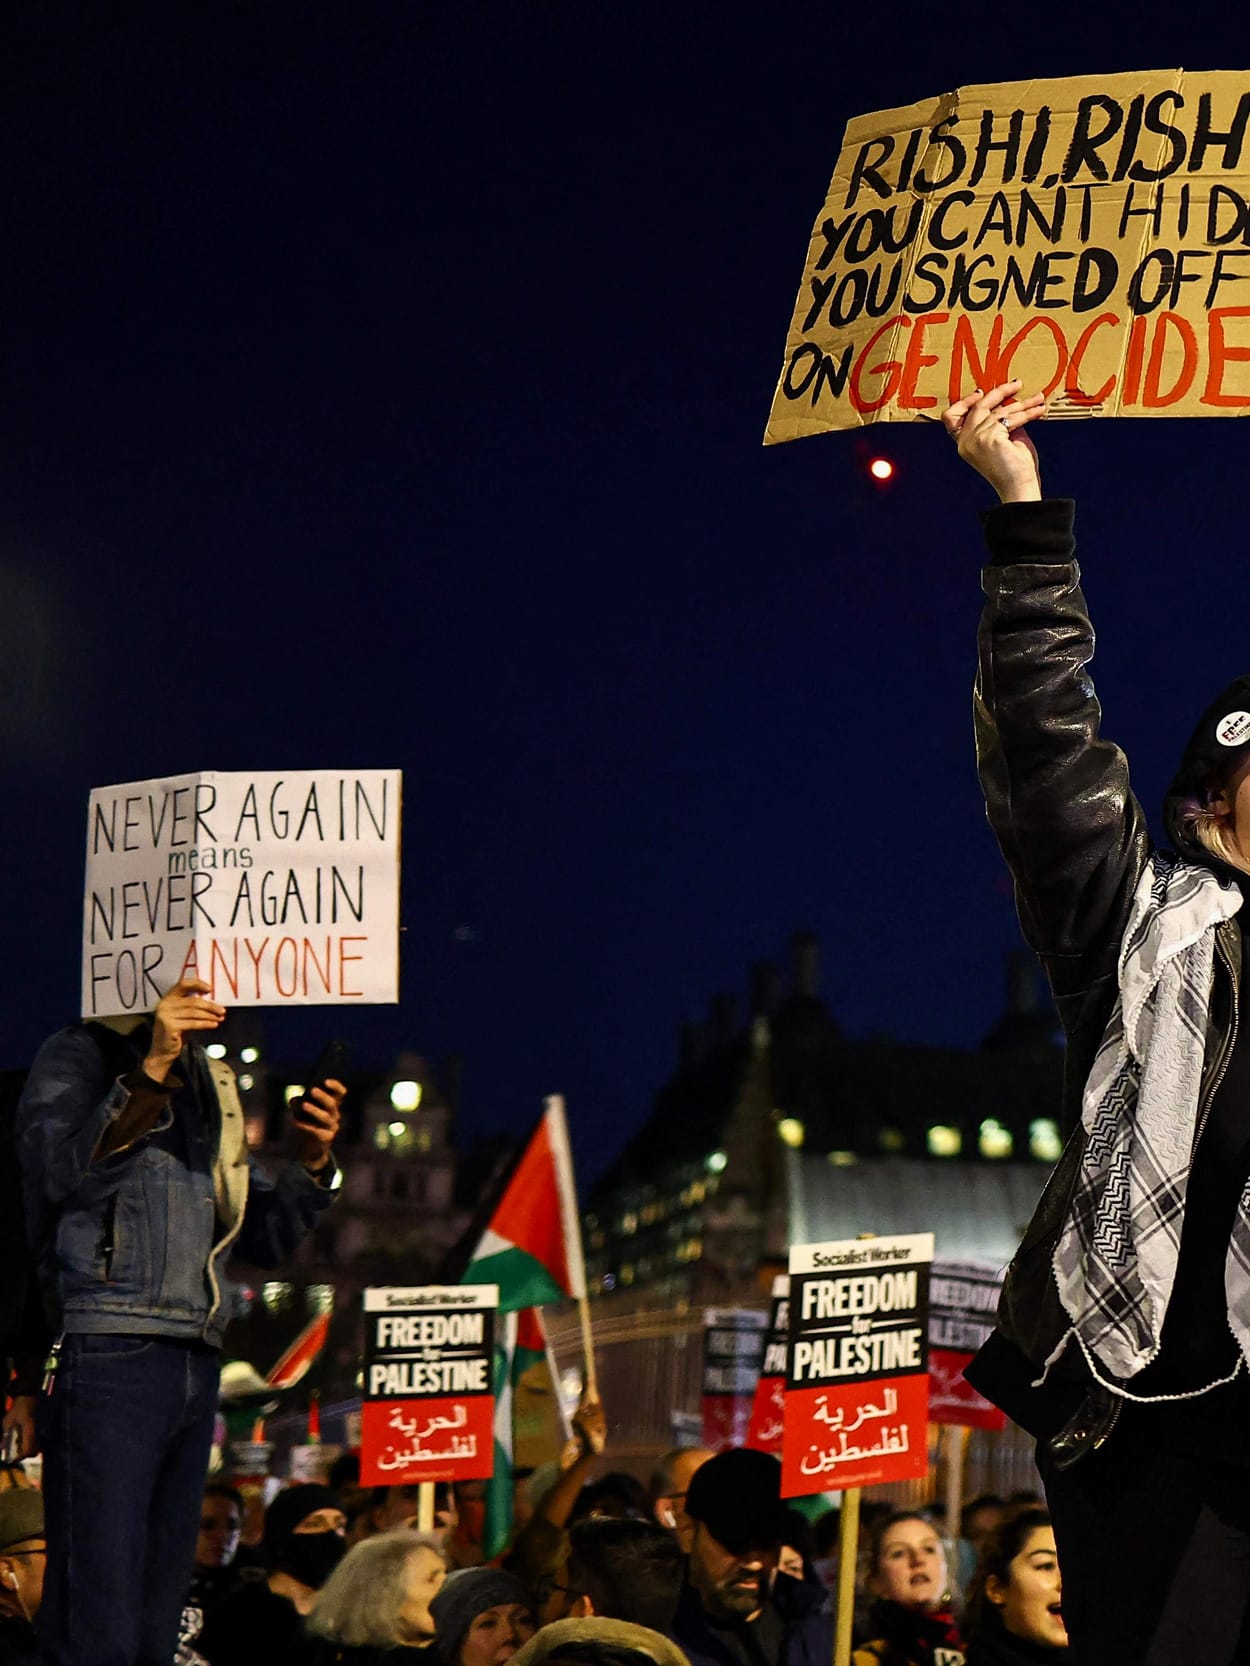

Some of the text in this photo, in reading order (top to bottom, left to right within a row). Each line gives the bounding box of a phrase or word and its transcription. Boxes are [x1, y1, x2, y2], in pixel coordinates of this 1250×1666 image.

[820, 197, 924, 270] YOU
[803, 260, 903, 332] YOU
[902, 246, 1118, 315] SIGNED
[782, 342, 853, 407] ON
[93, 778, 388, 855] NEVER AGAIN
[167, 846, 253, 873] means
[90, 864, 364, 945] NEVER AGAIN
[90, 935, 369, 1015] FOR ANYONE
[812, 1245, 912, 1268] Socialist Worker
[801, 1270, 918, 1320] FREEDOM
[376, 1312, 484, 1349] FREEDOM
[851, 1314, 873, 1335] for
[370, 1358, 489, 1395] PALESTINE
[792, 1327, 923, 1382] PALESTINE
[388, 1404, 468, 1438] الحرية
[812, 1387, 897, 1431] الحرية
[376, 1433, 477, 1471] لفلسطين
[800, 1423, 909, 1476] لفلسطين
